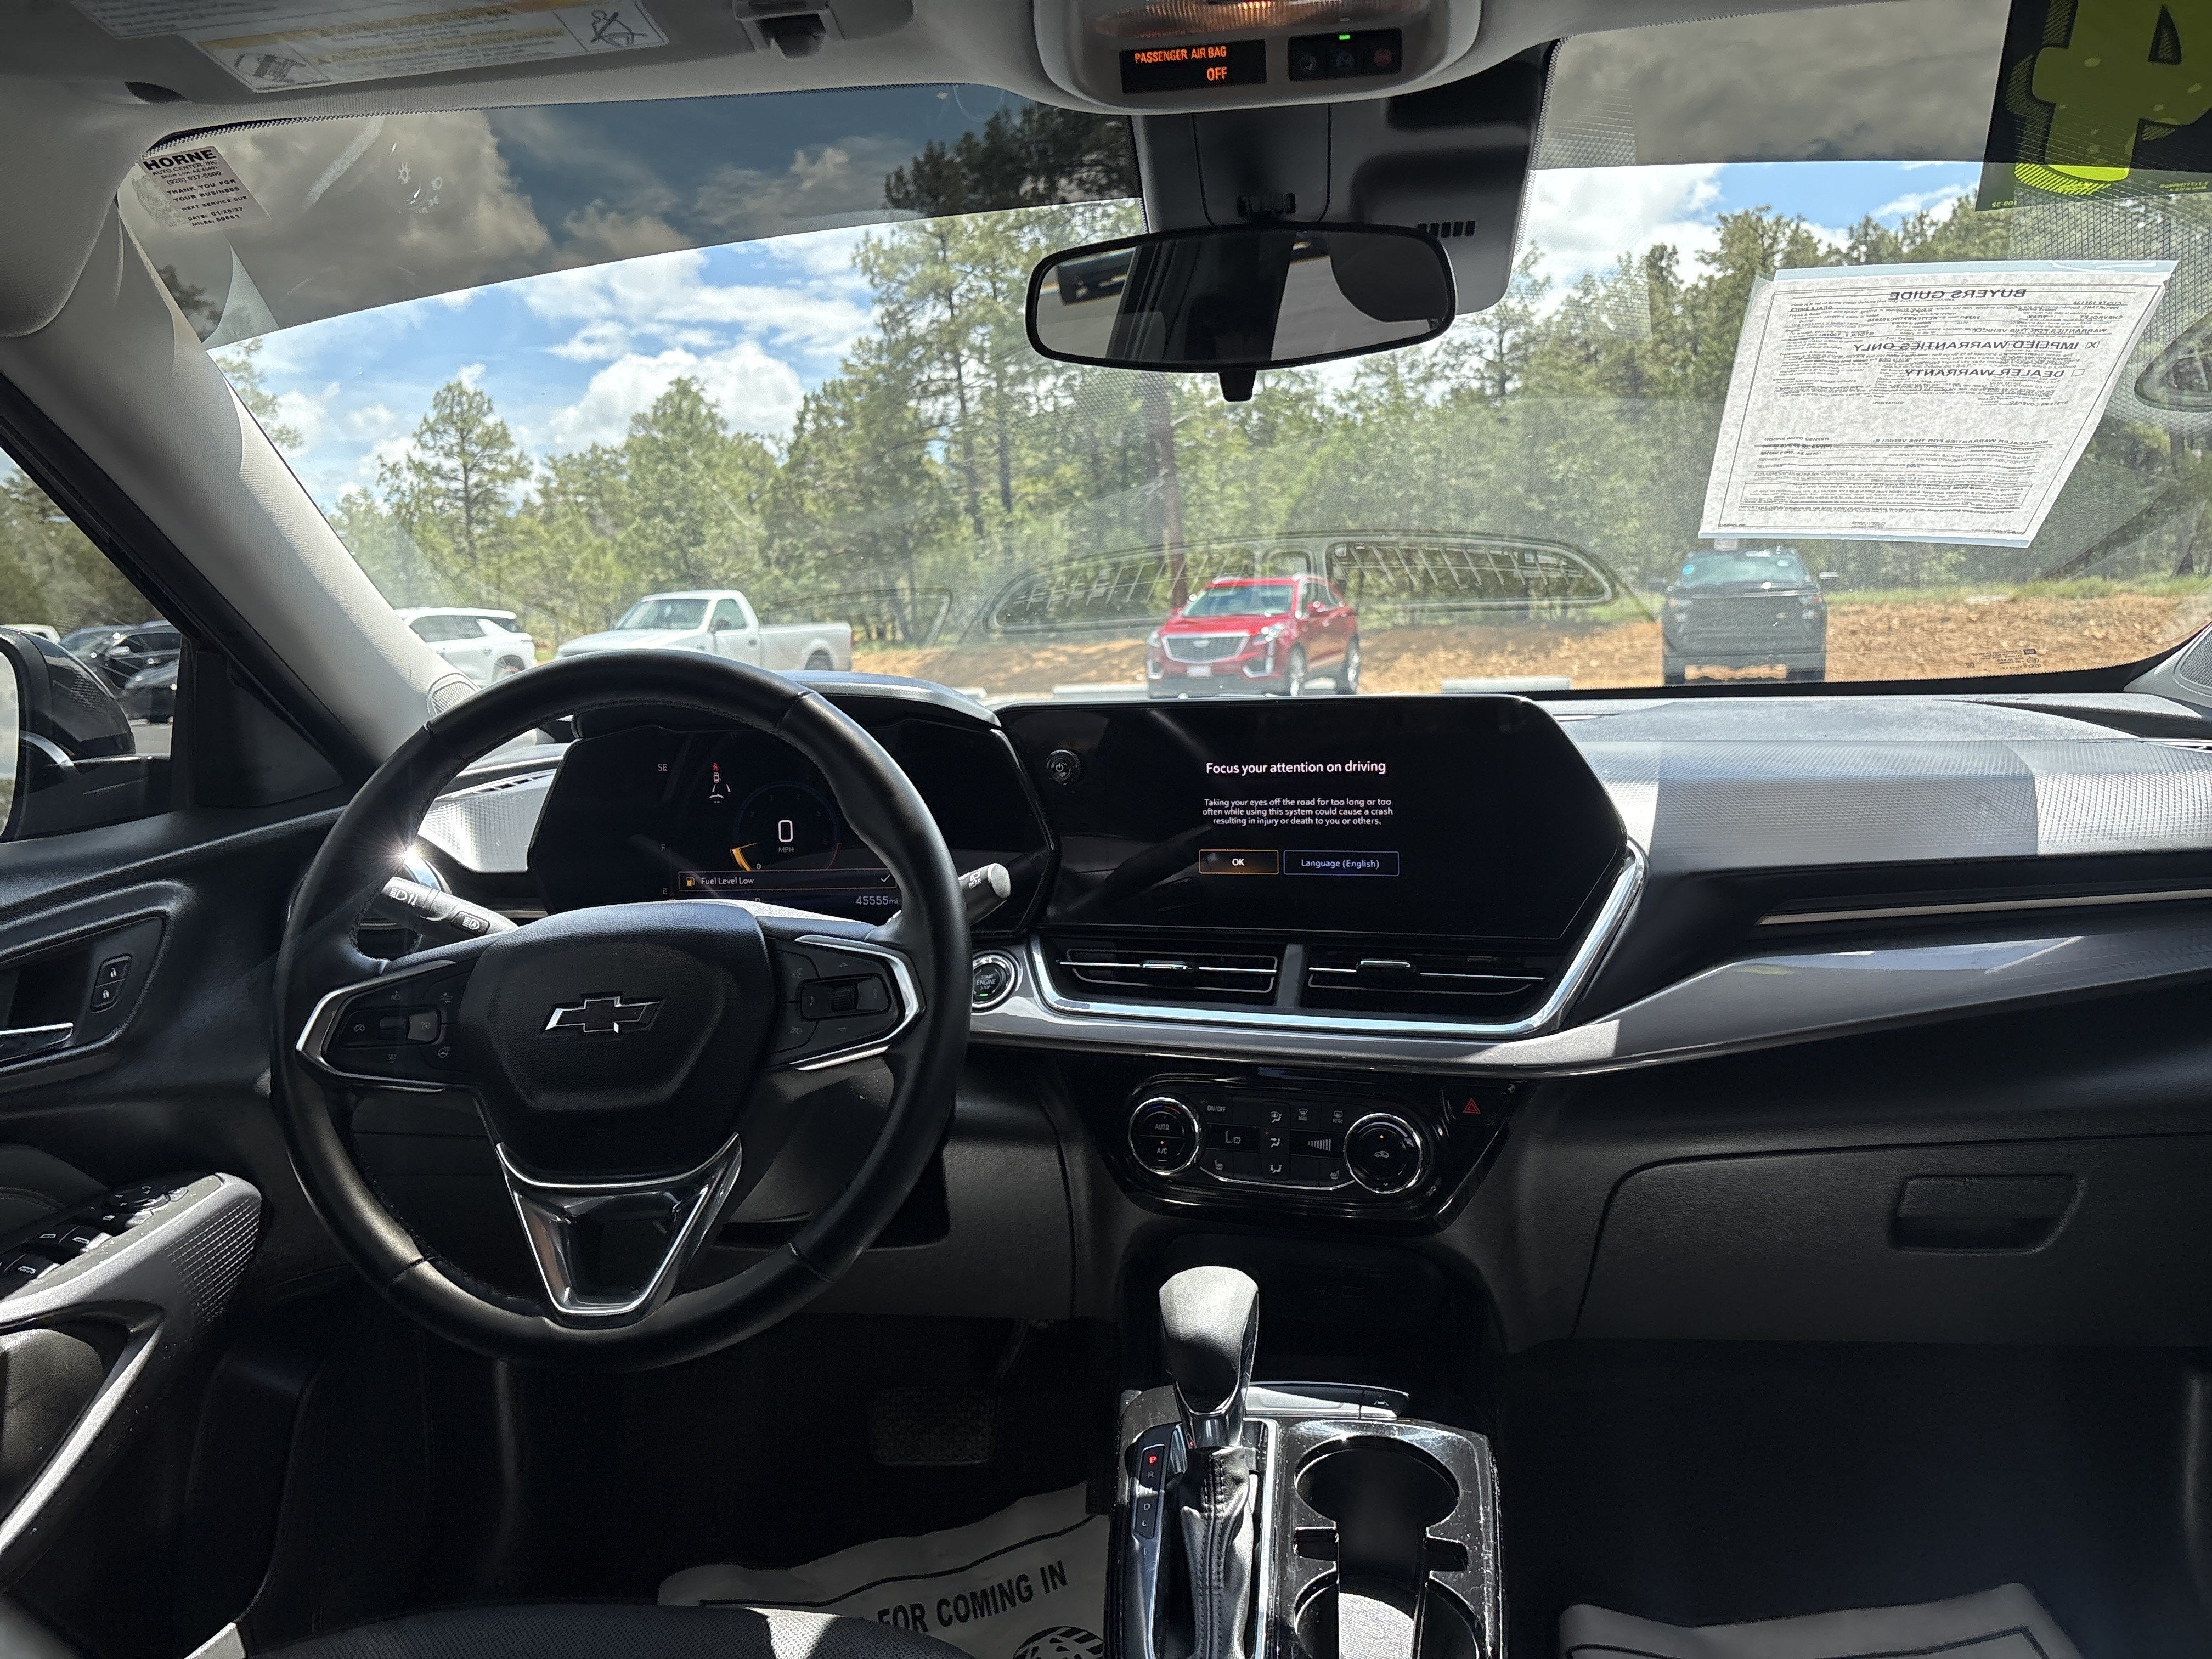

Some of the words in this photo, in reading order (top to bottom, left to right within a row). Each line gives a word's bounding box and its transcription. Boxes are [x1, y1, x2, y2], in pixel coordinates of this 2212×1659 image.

[1135, 49, 1188, 64] PASSENGER
[1191, 47, 1206, 59] AIR
[1207, 46, 1227, 58] BAG
[1207, 66, 1227, 81] OFF
[143, 149, 217, 170] HORNE
[166, 187, 196, 196] THANK
[173, 194, 197, 202] YOUR
[199, 187, 240, 198] BUSINESS
[202, 199, 232, 208] SERVICE
[657, 763, 668, 771] SE
[1206, 762, 1239, 774] Focus
[1242, 763, 1267, 776] your
[1269, 761, 1323, 772] attention
[1326, 763, 1342, 772] on
[1345, 760, 1386, 774] driving
[1204, 798, 1229, 808] Taking
[1231, 800, 1248, 809] your
[1250, 799, 1268, 809] eyes
[1269, 798, 1281, 806] off
[1297, 798, 1315, 806] road
[1317, 798, 1329, 806] for
[1346, 798, 1364, 808] long
[1202, 808, 1223, 816] often
[1246, 808, 1267, 817] using
[1268, 807, 1284, 815] this
[1285, 808, 1313, 817] system
[1314, 807, 1337, 815] could
[1370, 807, 1393, 815] crash
[1213, 816, 1247, 826] resulting
[1257, 817, 1279, 827] injury
[1290, 816, 1313, 825] death
[1325, 818, 1341, 827] you
[1352, 816, 1382, 825] others.
[778, 820, 794, 843] 0
[1232, 858, 1245, 867] OK
[1301, 859, 1340, 868] Language
[1342, 859, 1379, 870] (English)
[701, 877, 716, 885] Fuel
[968, 878, 982, 889] REAR
[1225, 1131, 1241, 1144] Lo
[1149, 1456, 1157, 1464] P
[936, 1573, 1034, 1627] COMING
[1039, 1560, 1068, 1594] IN
